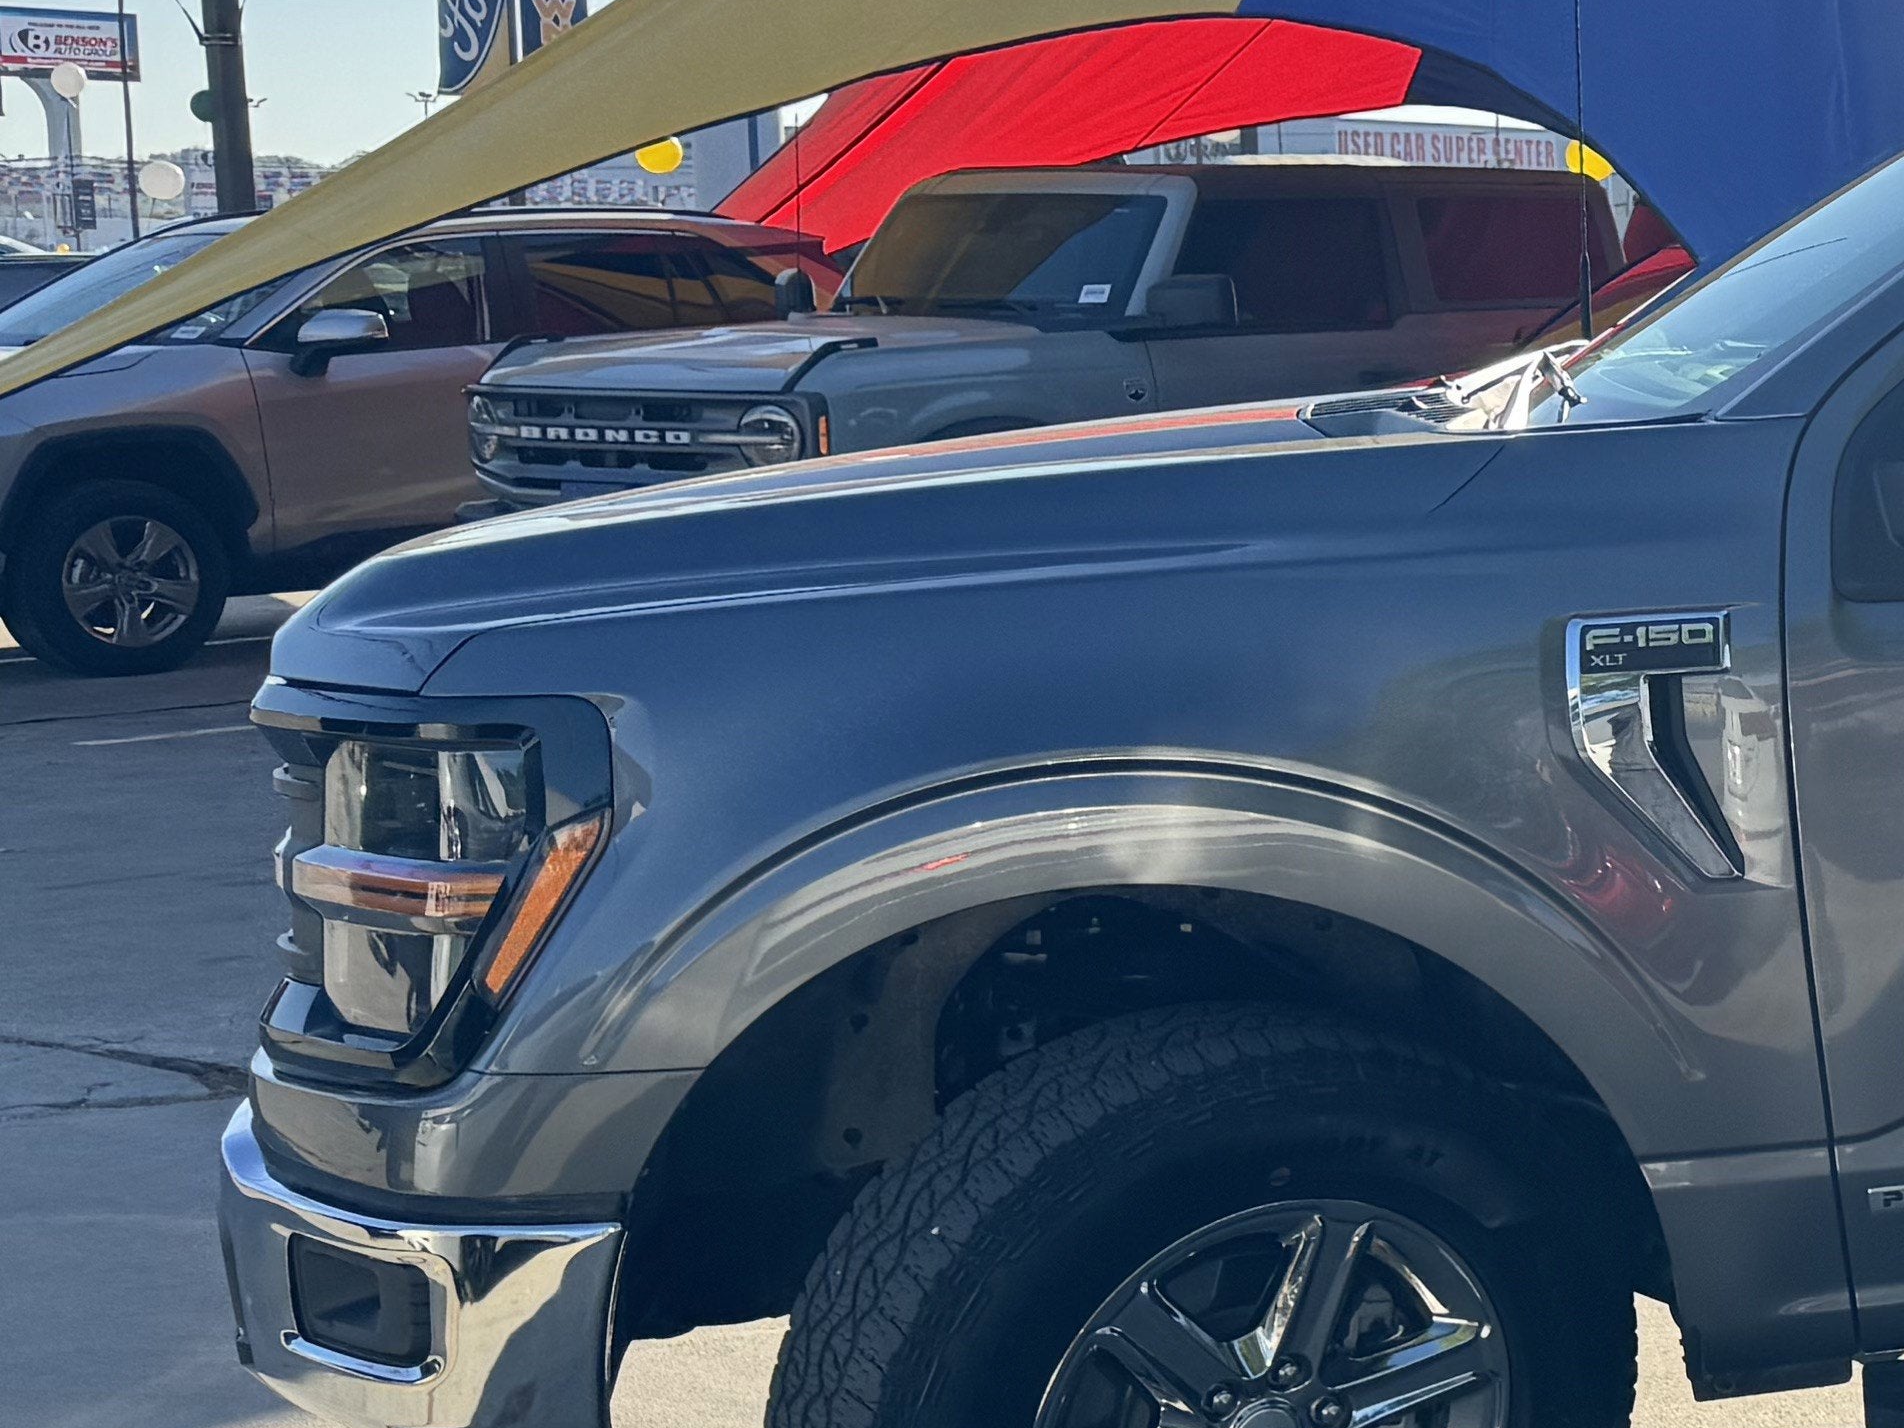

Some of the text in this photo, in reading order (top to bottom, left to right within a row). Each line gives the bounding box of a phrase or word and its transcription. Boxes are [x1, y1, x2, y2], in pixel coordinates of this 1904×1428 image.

[54, 35, 118, 49] BENSON'S
[54, 46, 118, 58] AUTO GROUP
[1338, 130, 1555, 168] USED CAR SUPER CENTER
[520, 425, 691, 445] BRONCO
[1585, 622, 1714, 651] F-150
[1590, 653, 1628, 667] XLT
